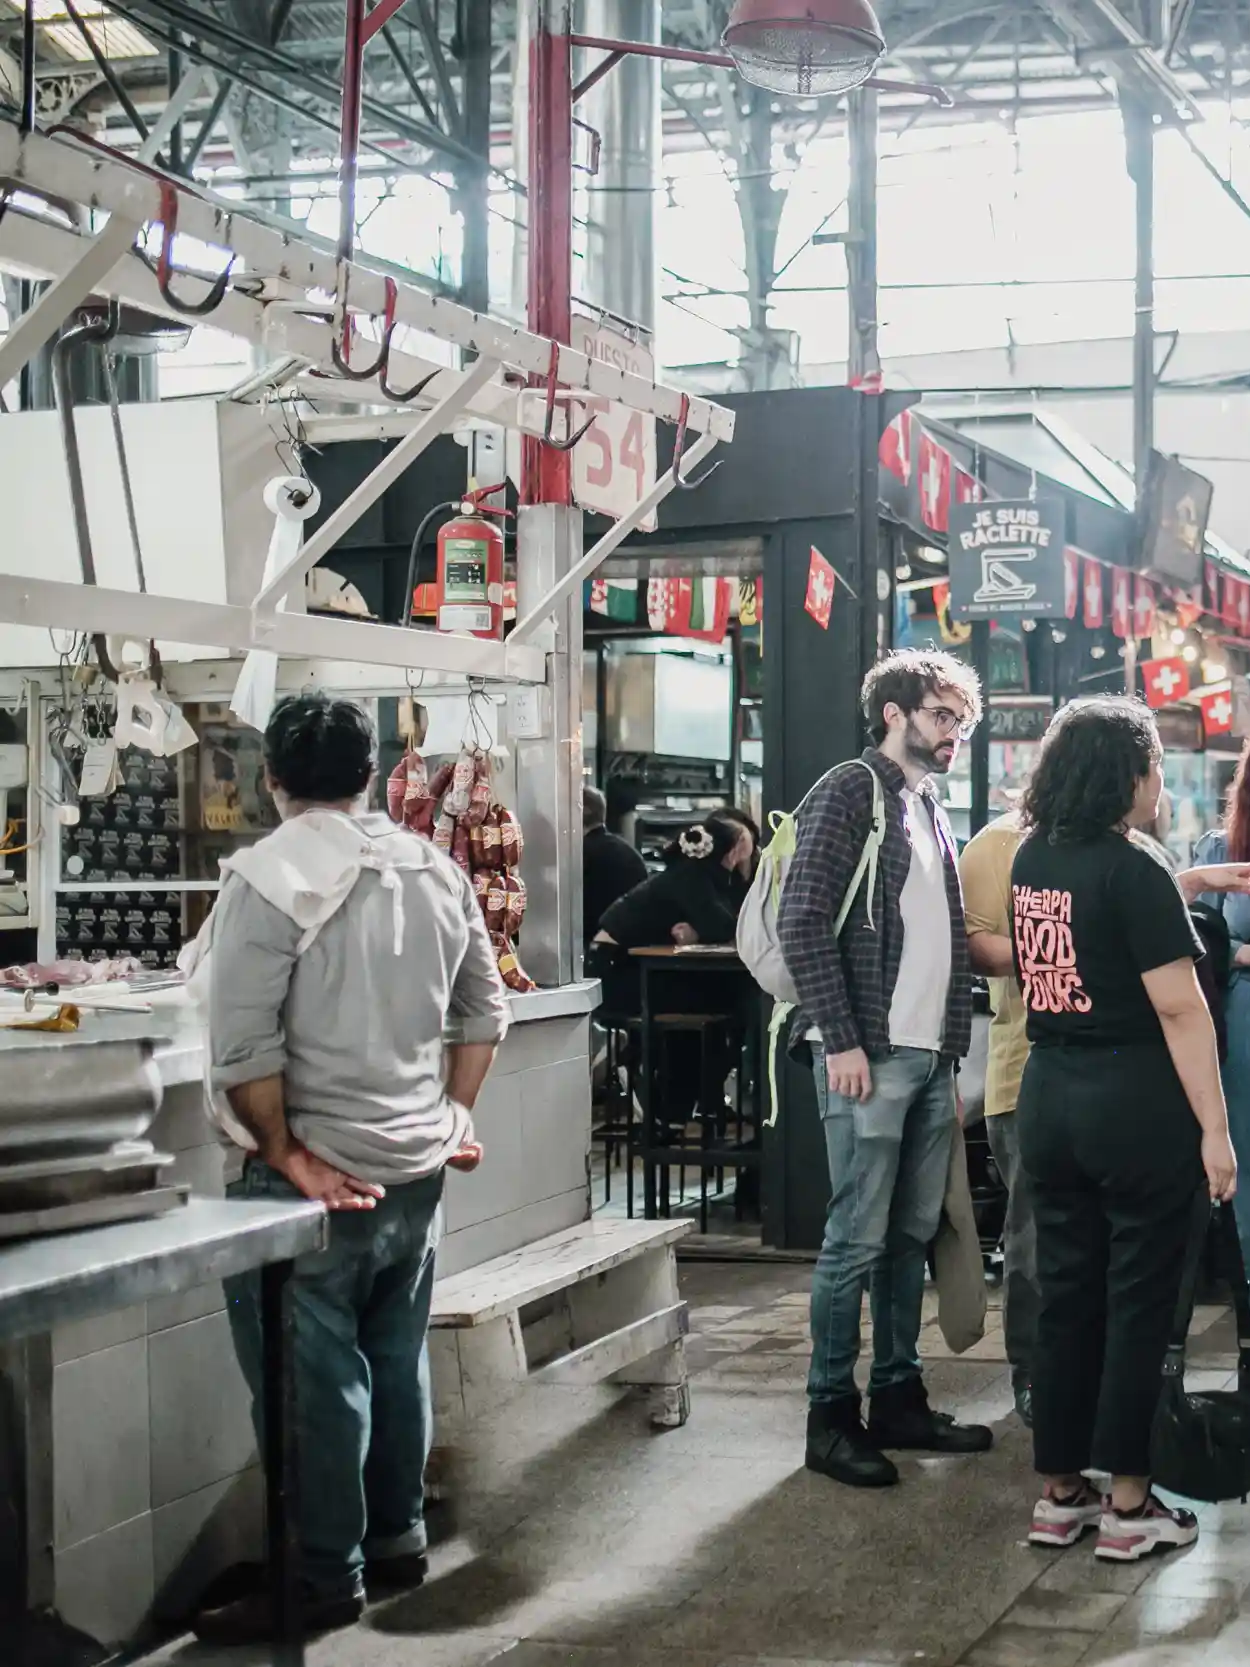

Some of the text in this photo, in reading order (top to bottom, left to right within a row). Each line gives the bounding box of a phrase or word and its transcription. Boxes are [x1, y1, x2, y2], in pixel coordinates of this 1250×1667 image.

[586, 399, 646, 502] 54
[960, 525, 1052, 550] RACLETTE
[972, 508, 1040, 528] JE SUIS
[1013, 884, 1072, 923] SHERPA
[1014, 916, 1076, 972] FOOD
[1021, 971, 1092, 1013] TOURS
